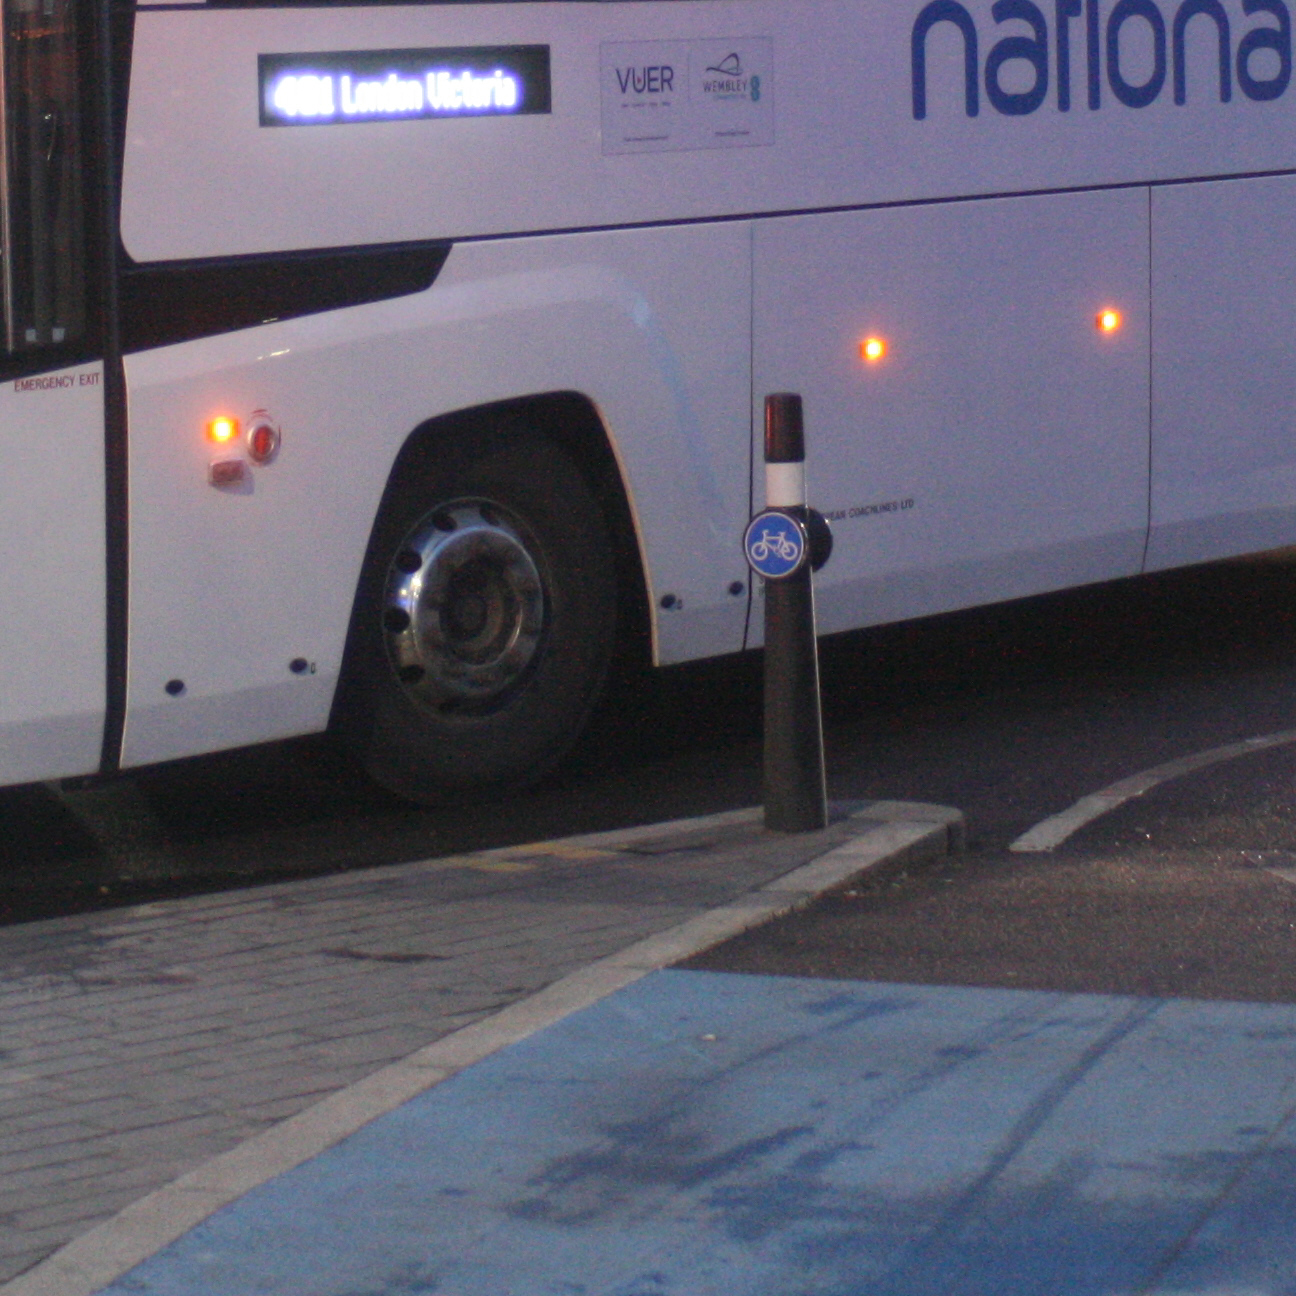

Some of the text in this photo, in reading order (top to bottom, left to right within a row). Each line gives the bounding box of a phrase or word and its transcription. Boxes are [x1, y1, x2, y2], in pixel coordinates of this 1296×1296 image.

[426, 69, 517, 110] Victoria
[704, 79, 747, 92] WEMBLEY
[14, 373, 100, 392] EMERGENCY EXIT
